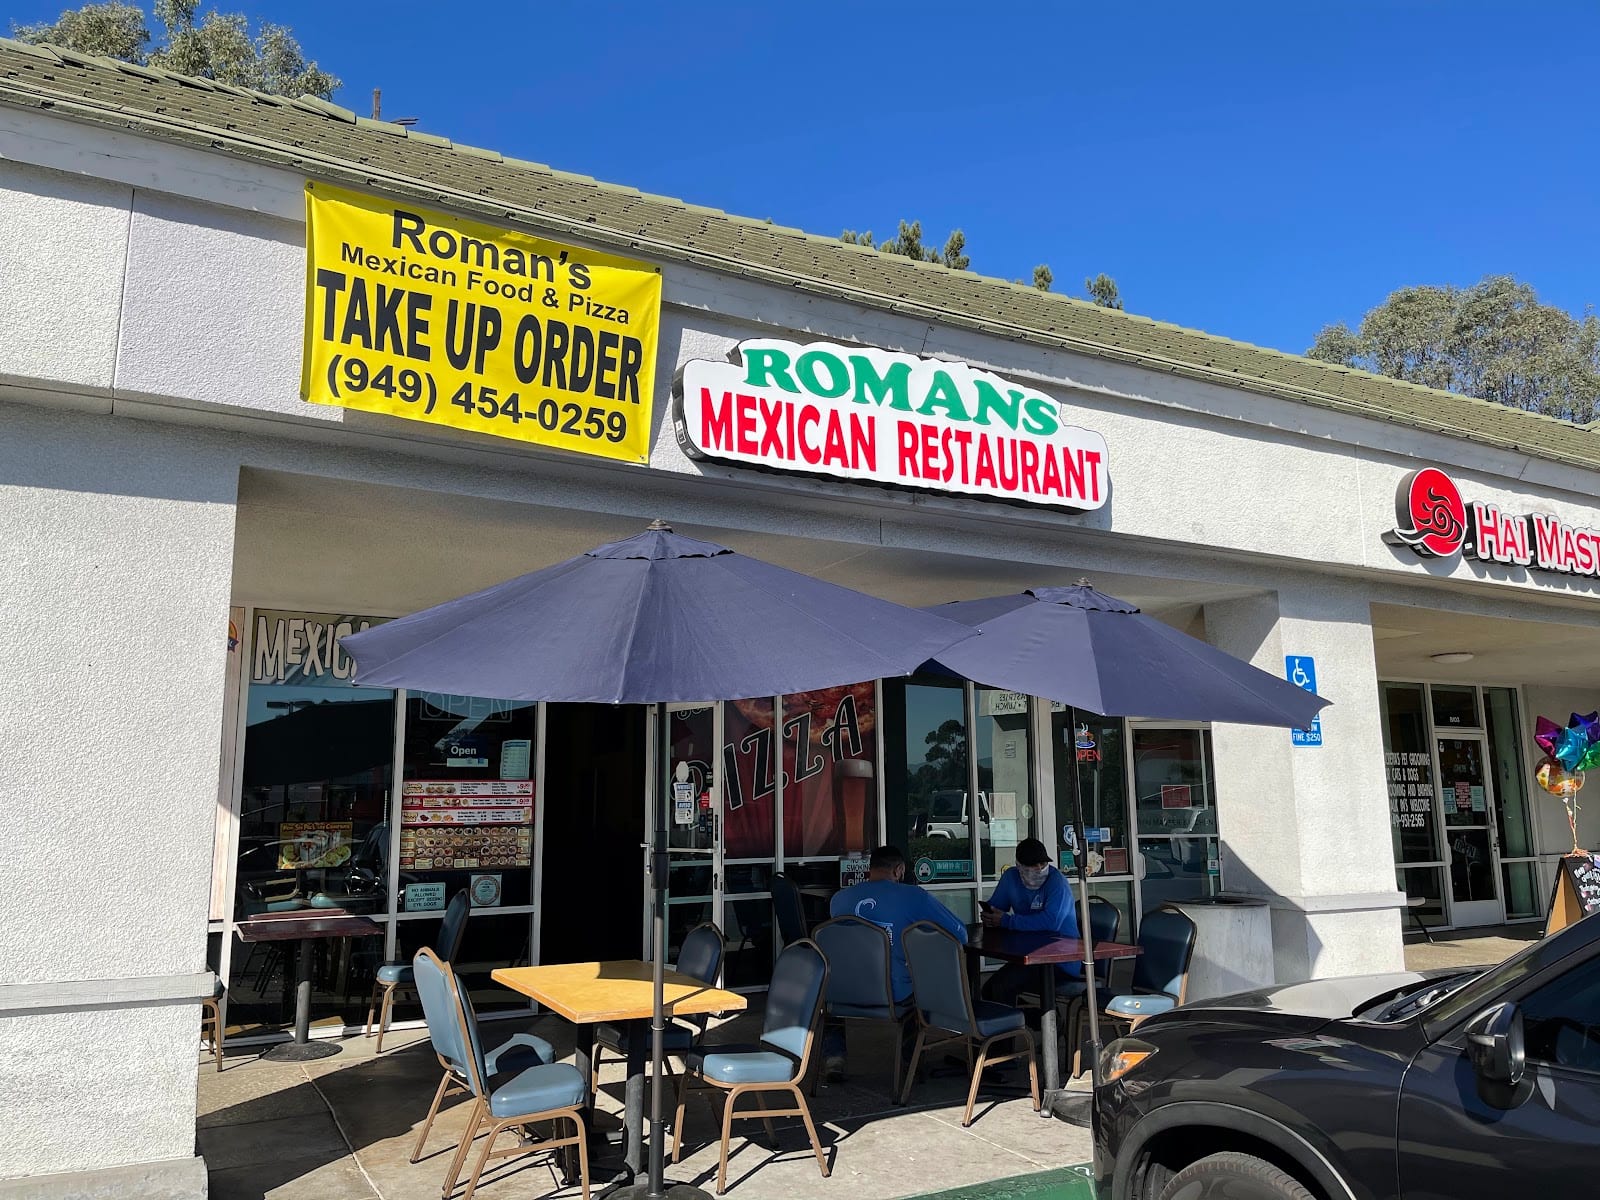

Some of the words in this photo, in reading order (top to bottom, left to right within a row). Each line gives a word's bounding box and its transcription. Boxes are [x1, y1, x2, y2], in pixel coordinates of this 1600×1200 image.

[340, 242, 457, 287] Mexican
[467, 270, 533, 303] Food
[542, 288, 559, 308] &
[568, 293, 630, 324] Pizza
[391, 208, 592, 290] Roman's
[316, 267, 433, 362] TAKE
[444, 298, 501, 375] UP
[514, 313, 643, 404] ORDER
[326, 354, 437, 414] (949)
[450, 381, 627, 443] 454-0259
[741, 348, 1061, 436] ROMANS
[700, 386, 877, 472] MEXICAN
[896, 419, 1101, 502] RESTAURANT
[1474, 503, 1530, 563] HAI
[450, 745, 477, 756] Open
[1292, 732, 1305, 742] FINE
[1306, 732, 1321, 742] $250
